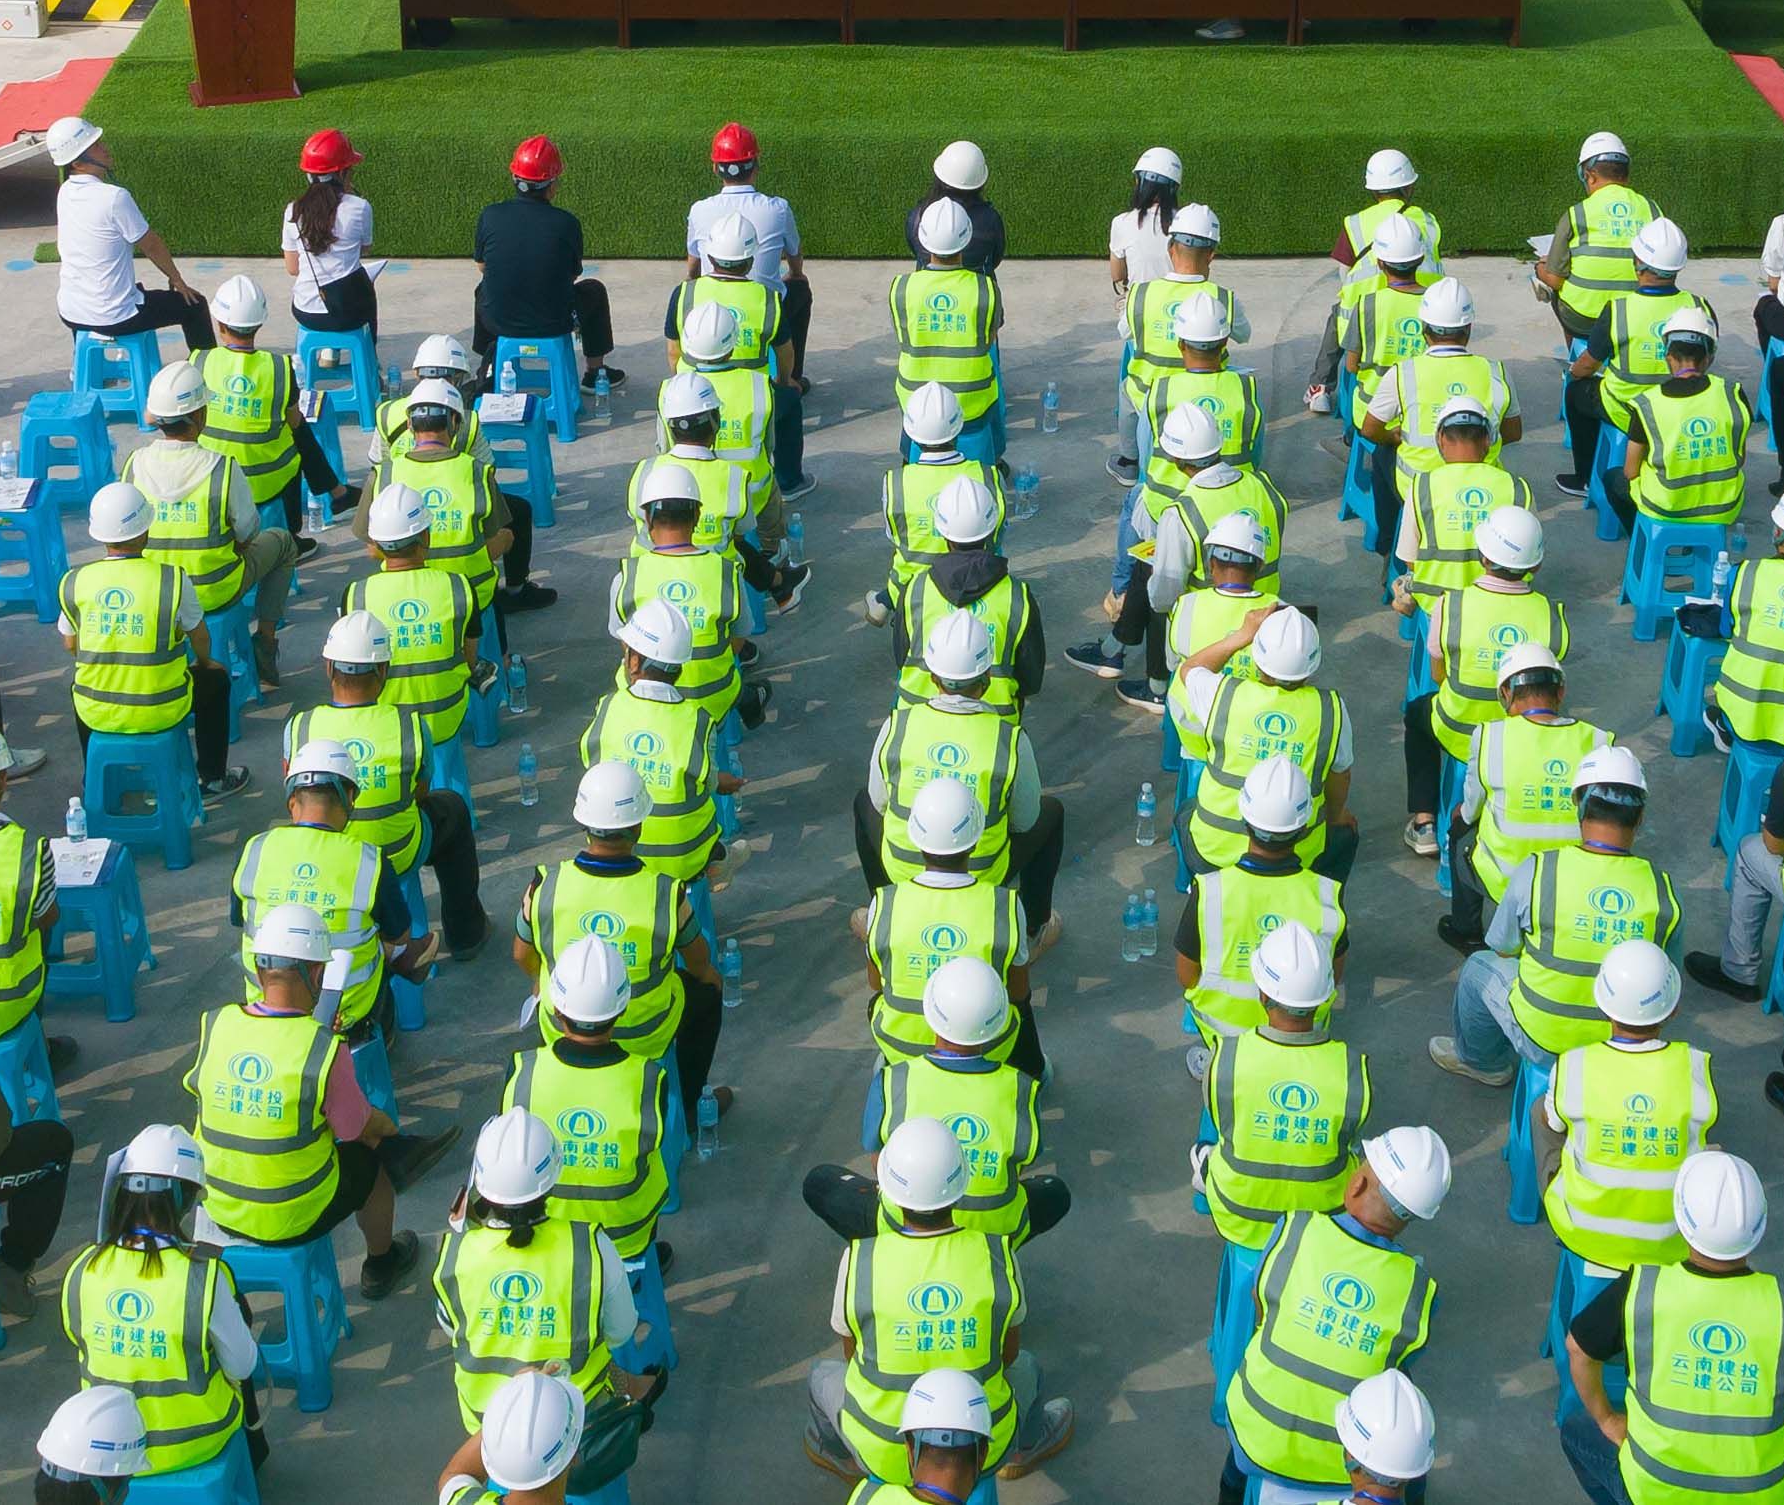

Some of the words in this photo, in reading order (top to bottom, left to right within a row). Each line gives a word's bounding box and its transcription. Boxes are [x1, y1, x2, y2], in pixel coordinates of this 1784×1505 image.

[213, 1083, 283, 1105] 云南建投
[215, 1099, 283, 1120] 二建公司
[1254, 1110, 1330, 1133] 云南建投
[1602, 1123, 1679, 1141] 云南建投
[1253, 1125, 1328, 1146] 二建公司
[562, 1140, 619, 1156] 南建投
[1602, 1139, 1679, 1158] 二建公司
[562, 1154, 619, 1169] 建公司
[479, 1306, 557, 1325] 云南建投
[894, 1317, 978, 1335] 云南建投
[1300, 1297, 1381, 1343] 云南建投
[94, 1322, 166, 1345] 云南建投
[480, 1320, 557, 1339] 二建公司
[1295, 1314, 1375, 1357] 二建公司
[94, 1338, 166, 1360] 二建公司
[894, 1334, 977, 1351] 二建公司
[1672, 1353, 1759, 1380] 云南建投
[1671, 1371, 1758, 1397] 二建公司
